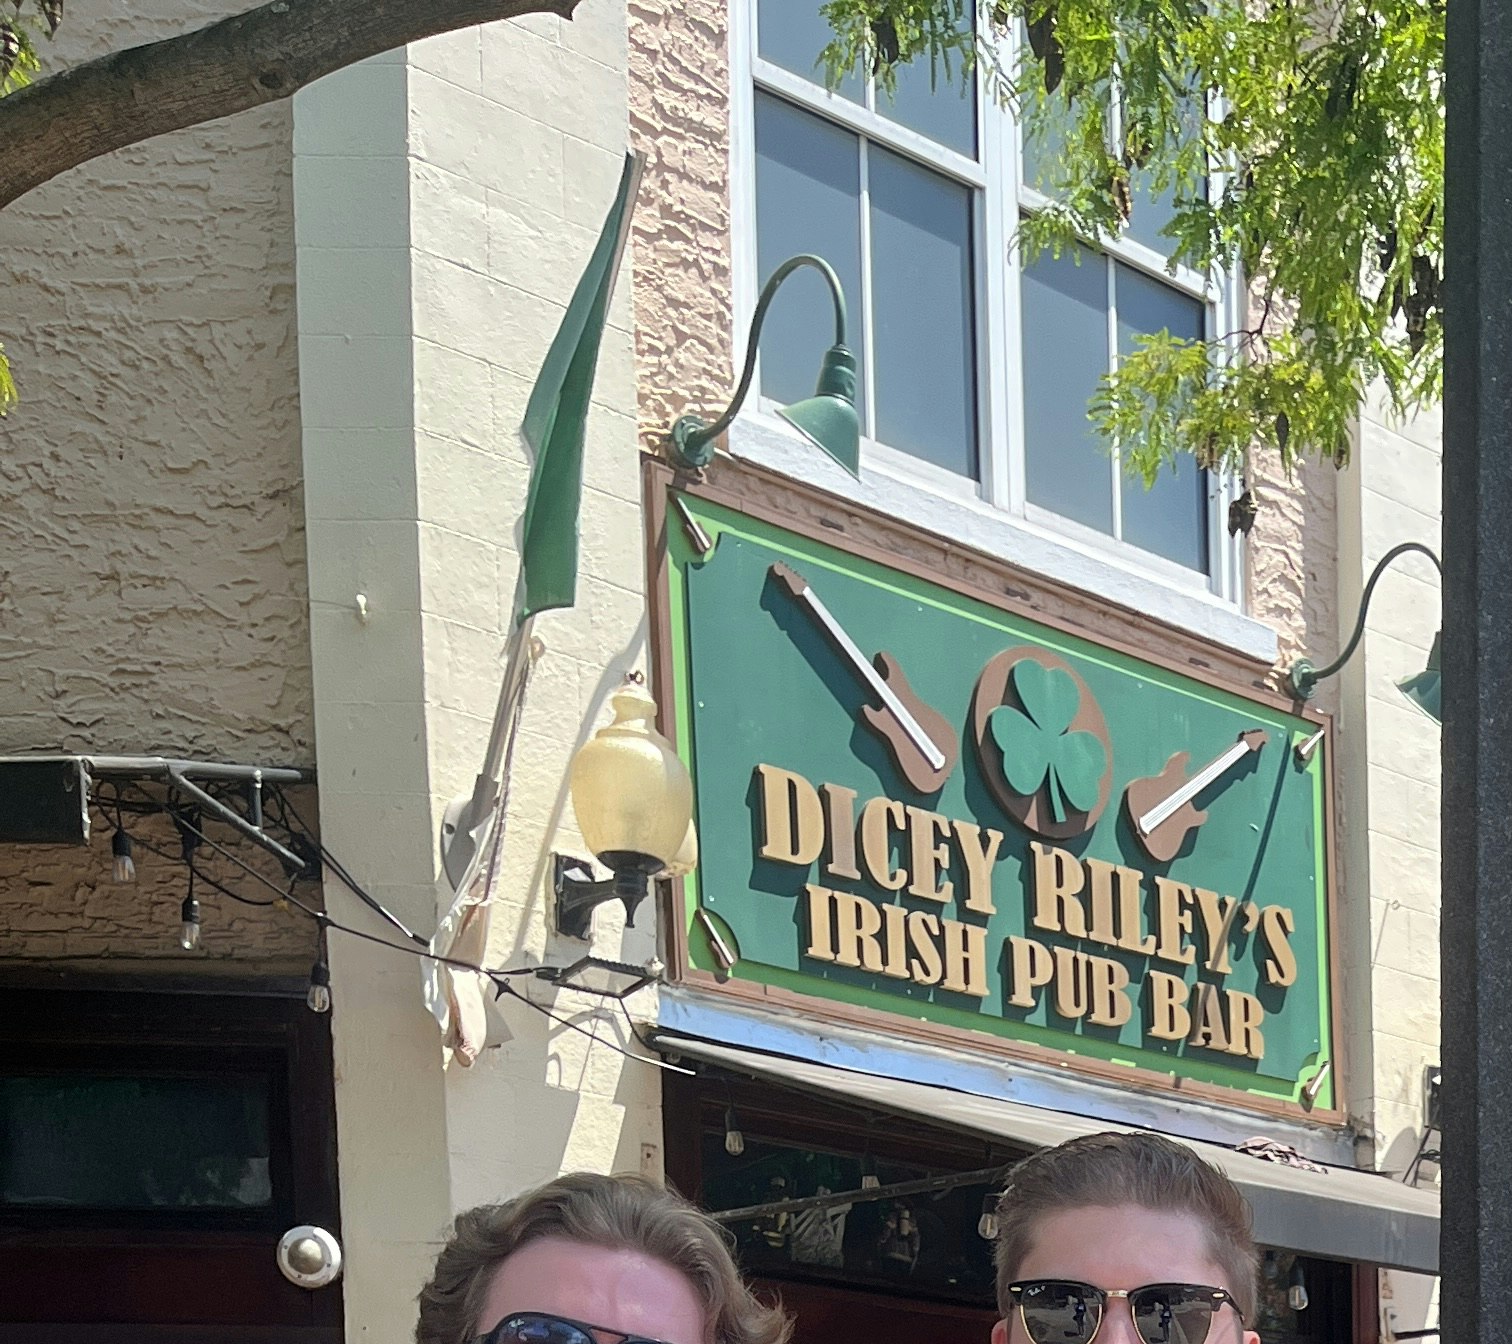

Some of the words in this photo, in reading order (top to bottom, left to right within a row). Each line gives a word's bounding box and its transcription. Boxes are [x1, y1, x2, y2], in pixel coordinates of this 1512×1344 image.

[758, 763, 1004, 915] DICEY
[1030, 841, 1298, 987] RILEY'S
[804, 883, 990, 997] IRISH
[1008, 935, 1132, 1027] PUB
[1147, 968, 1265, 1060] BAR
